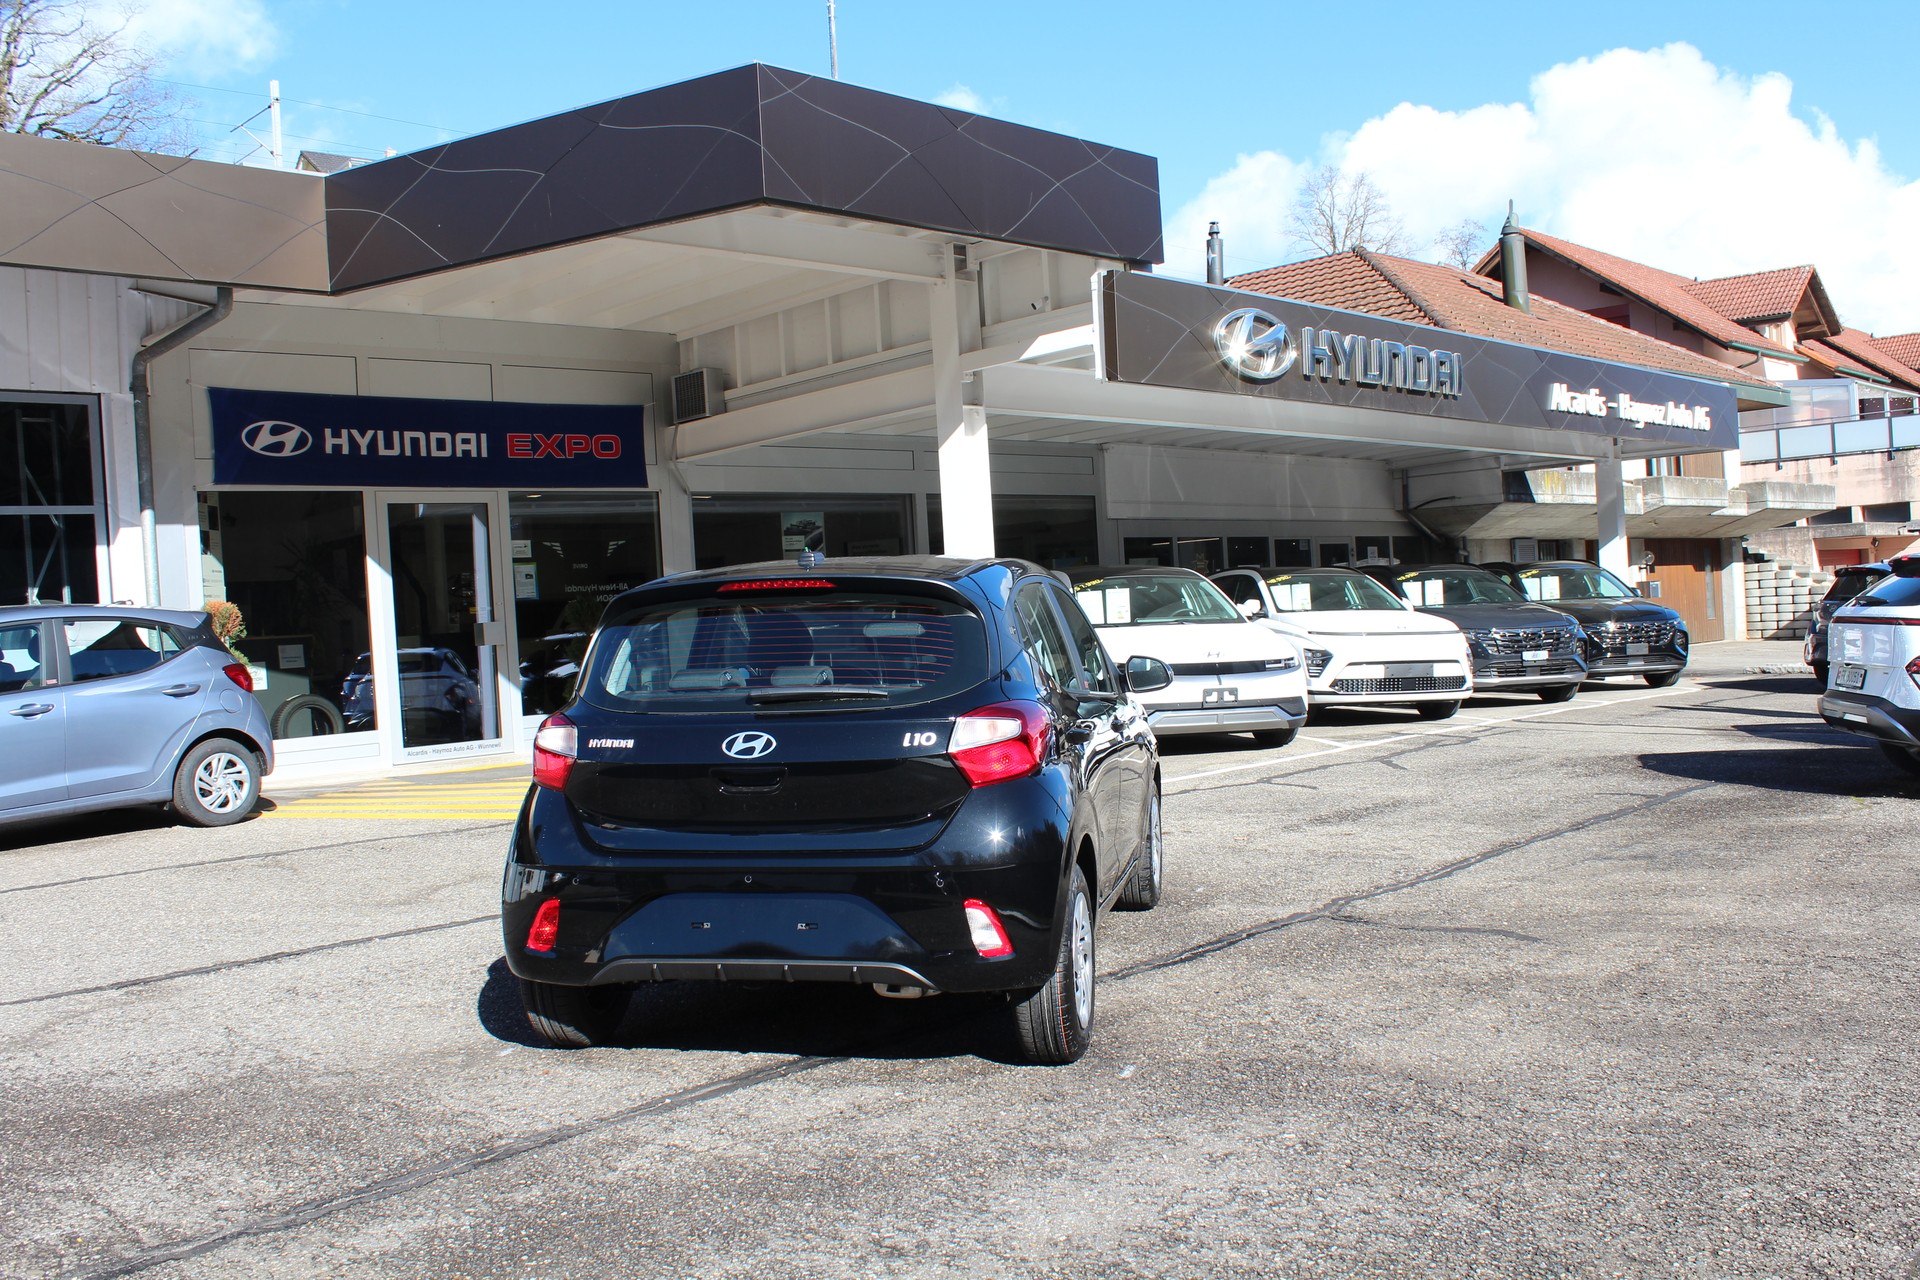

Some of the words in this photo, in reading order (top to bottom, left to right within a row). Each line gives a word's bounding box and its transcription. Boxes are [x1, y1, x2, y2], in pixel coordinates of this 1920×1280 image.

[1302, 327, 1463, 397] HYUNDAI
[324, 428, 488, 458] HYUNDAI
[507, 433, 622, 459] EXPO
[588, 738, 635, 749] HYUNDAI
